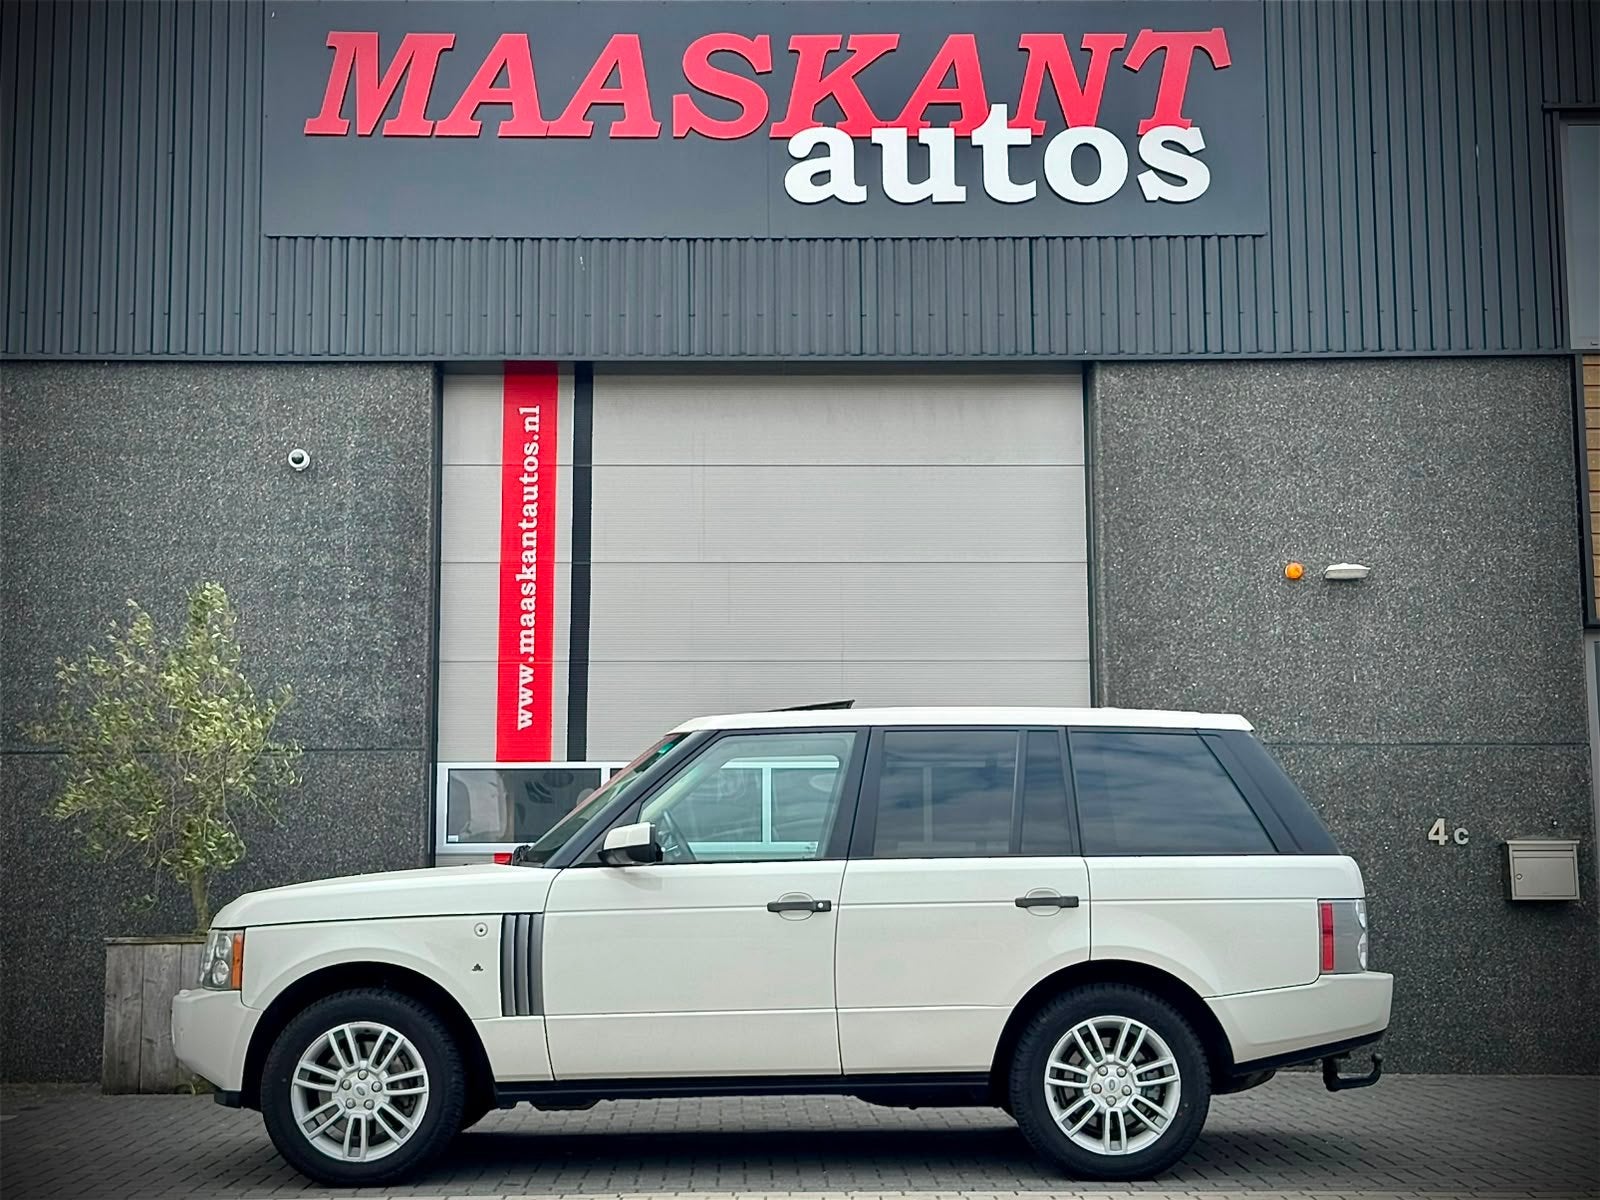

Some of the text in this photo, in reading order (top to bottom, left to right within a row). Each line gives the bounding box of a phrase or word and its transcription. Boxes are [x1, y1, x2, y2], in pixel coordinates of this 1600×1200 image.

[304, 28, 1232, 139] MAASKANT
[784, 103, 1211, 204] autos
[516, 405, 540, 730] www.maaskantautos.nl
